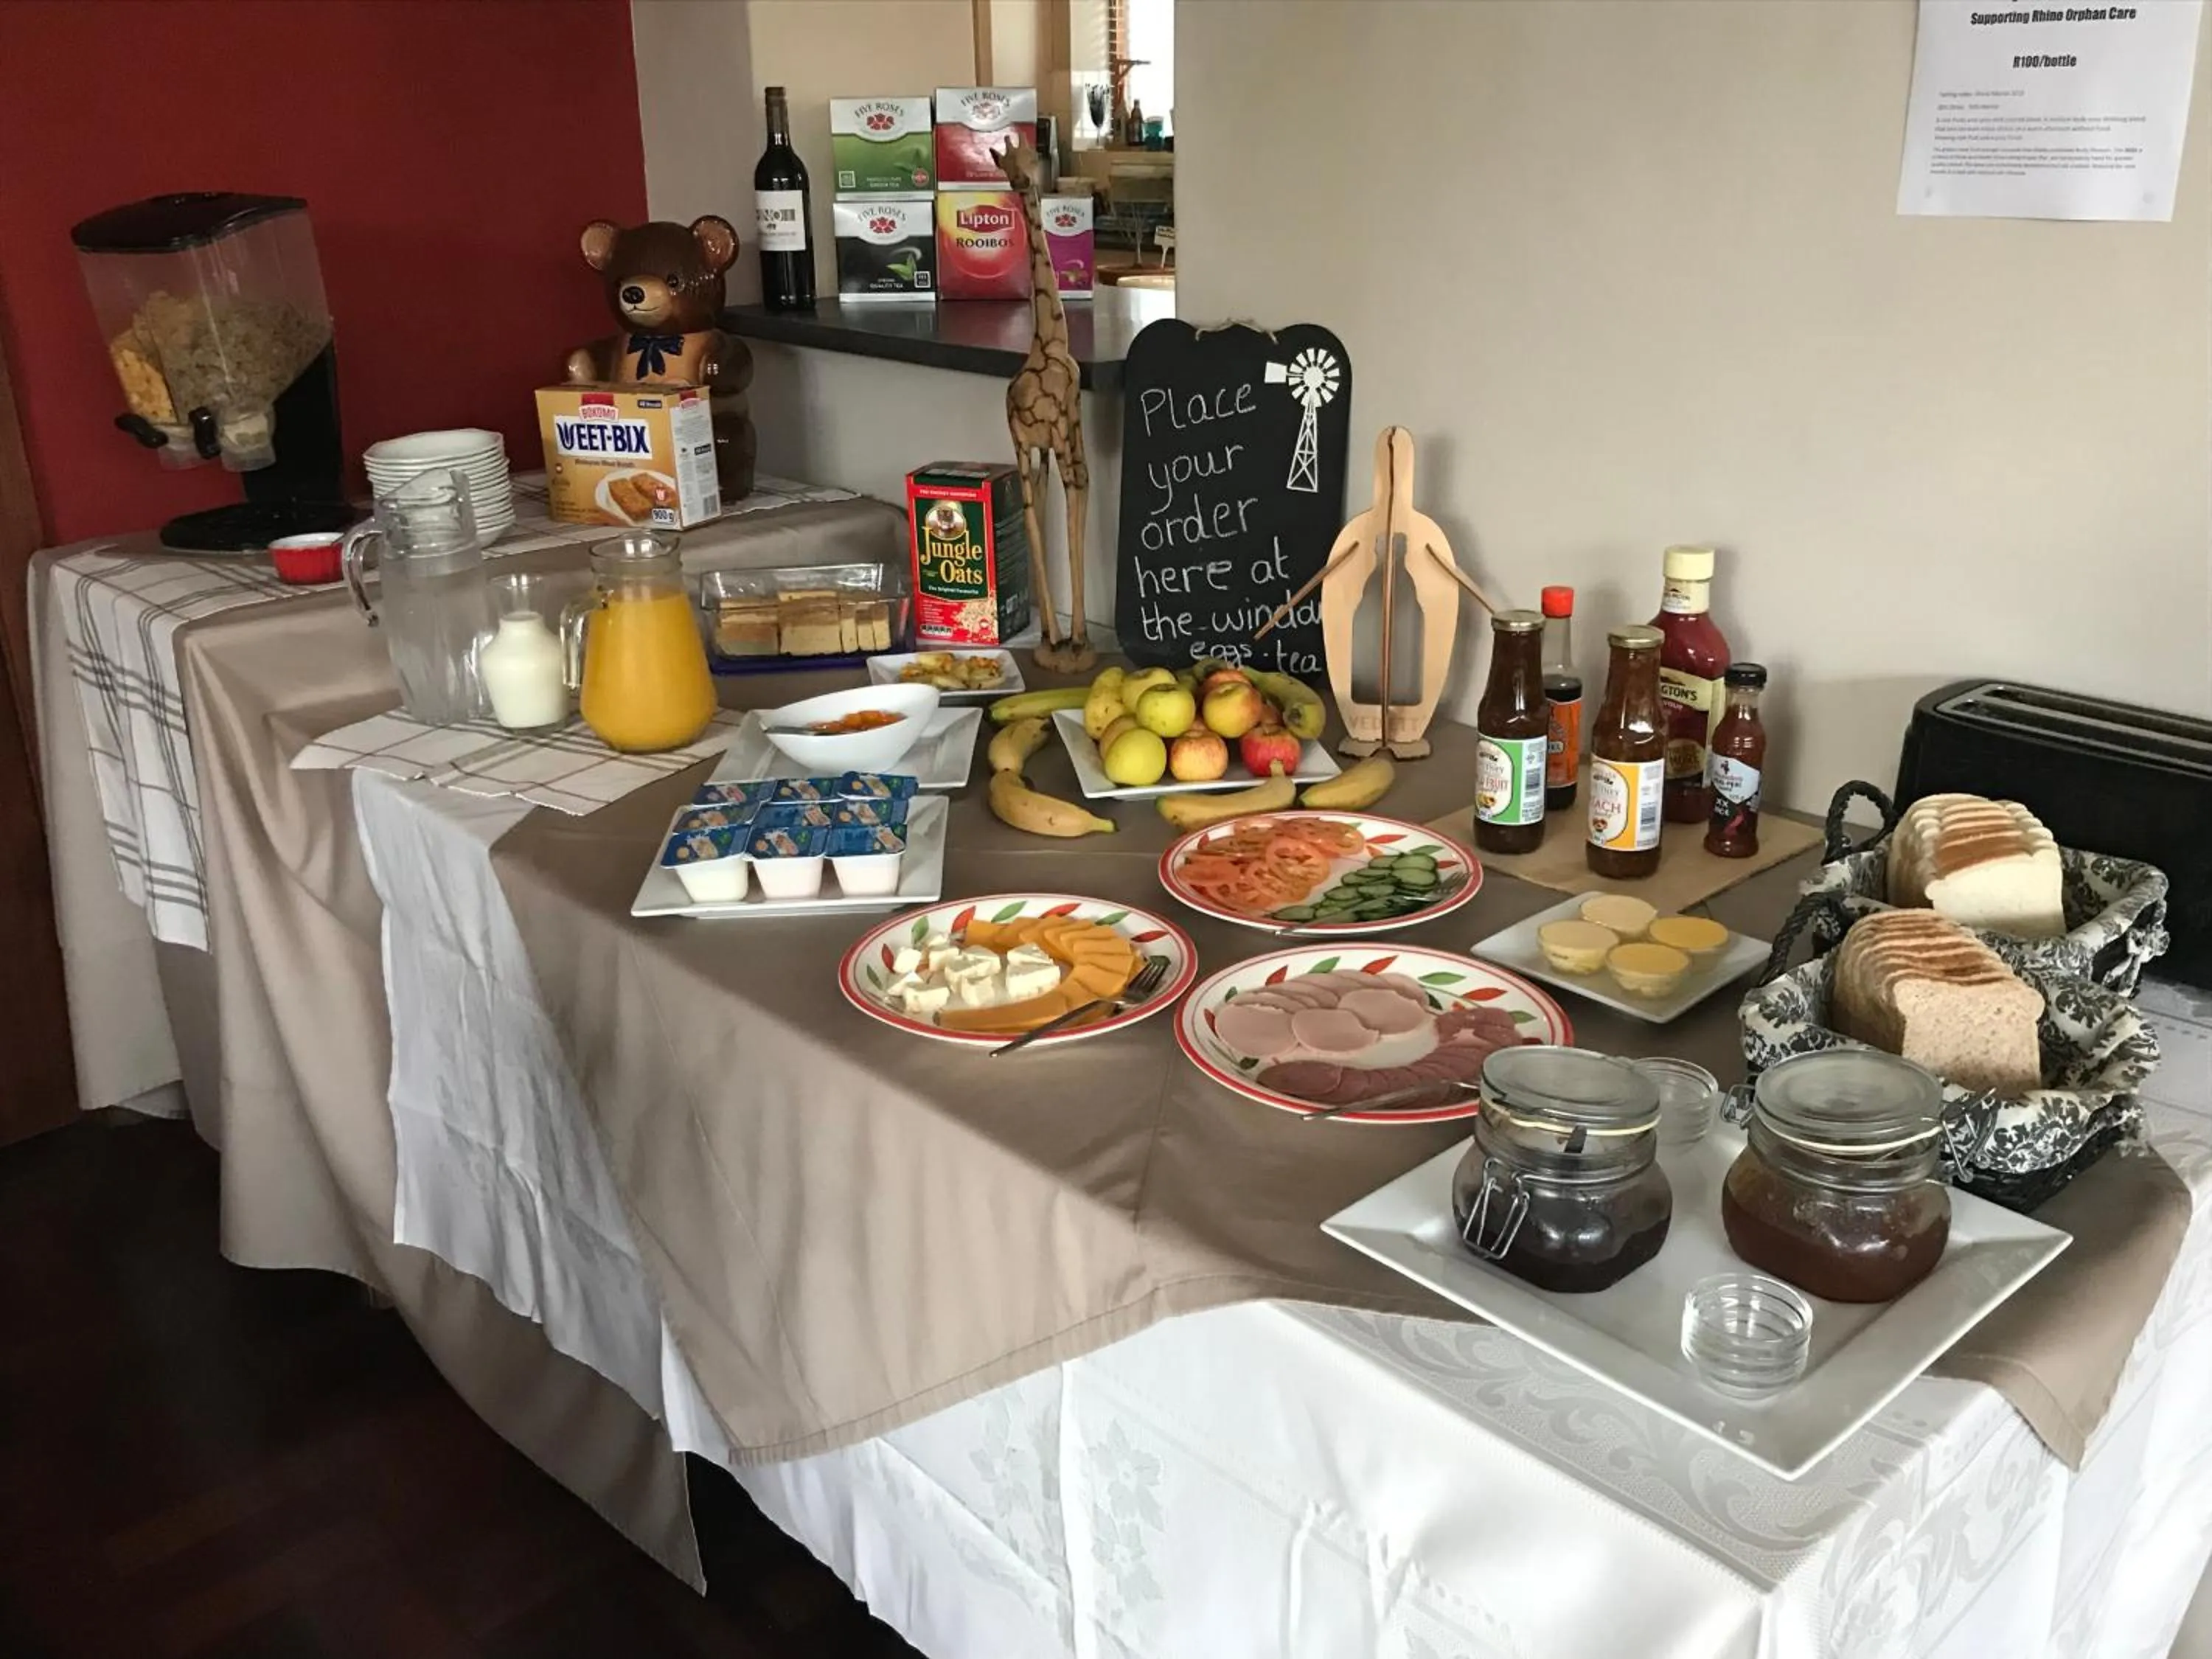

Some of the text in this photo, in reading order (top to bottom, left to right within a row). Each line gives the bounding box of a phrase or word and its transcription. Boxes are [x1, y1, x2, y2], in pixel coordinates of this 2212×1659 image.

[1970, 7, 2137, 25] Supporting Rhino Orphan Care
[2012, 55, 2077, 68] R100/bottle
[855, 102, 904, 118] FIVE ROSES
[960, 212, 1009, 228] Lipton
[956, 237, 1015, 248] ROOIBOS
[1140, 383, 1256, 437] Place
[556, 422, 650, 453] WEET-BIX
[1147, 443, 1245, 515] your
[653, 509, 667, 520] 900
[1140, 493, 1259, 550] order
[919, 526, 983, 567] Jungle
[940, 560, 984, 585] Oats
[1134, 536, 1290, 598] here at
[1140, 602, 1192, 641] the
[1276, 639, 1322, 674] tea
